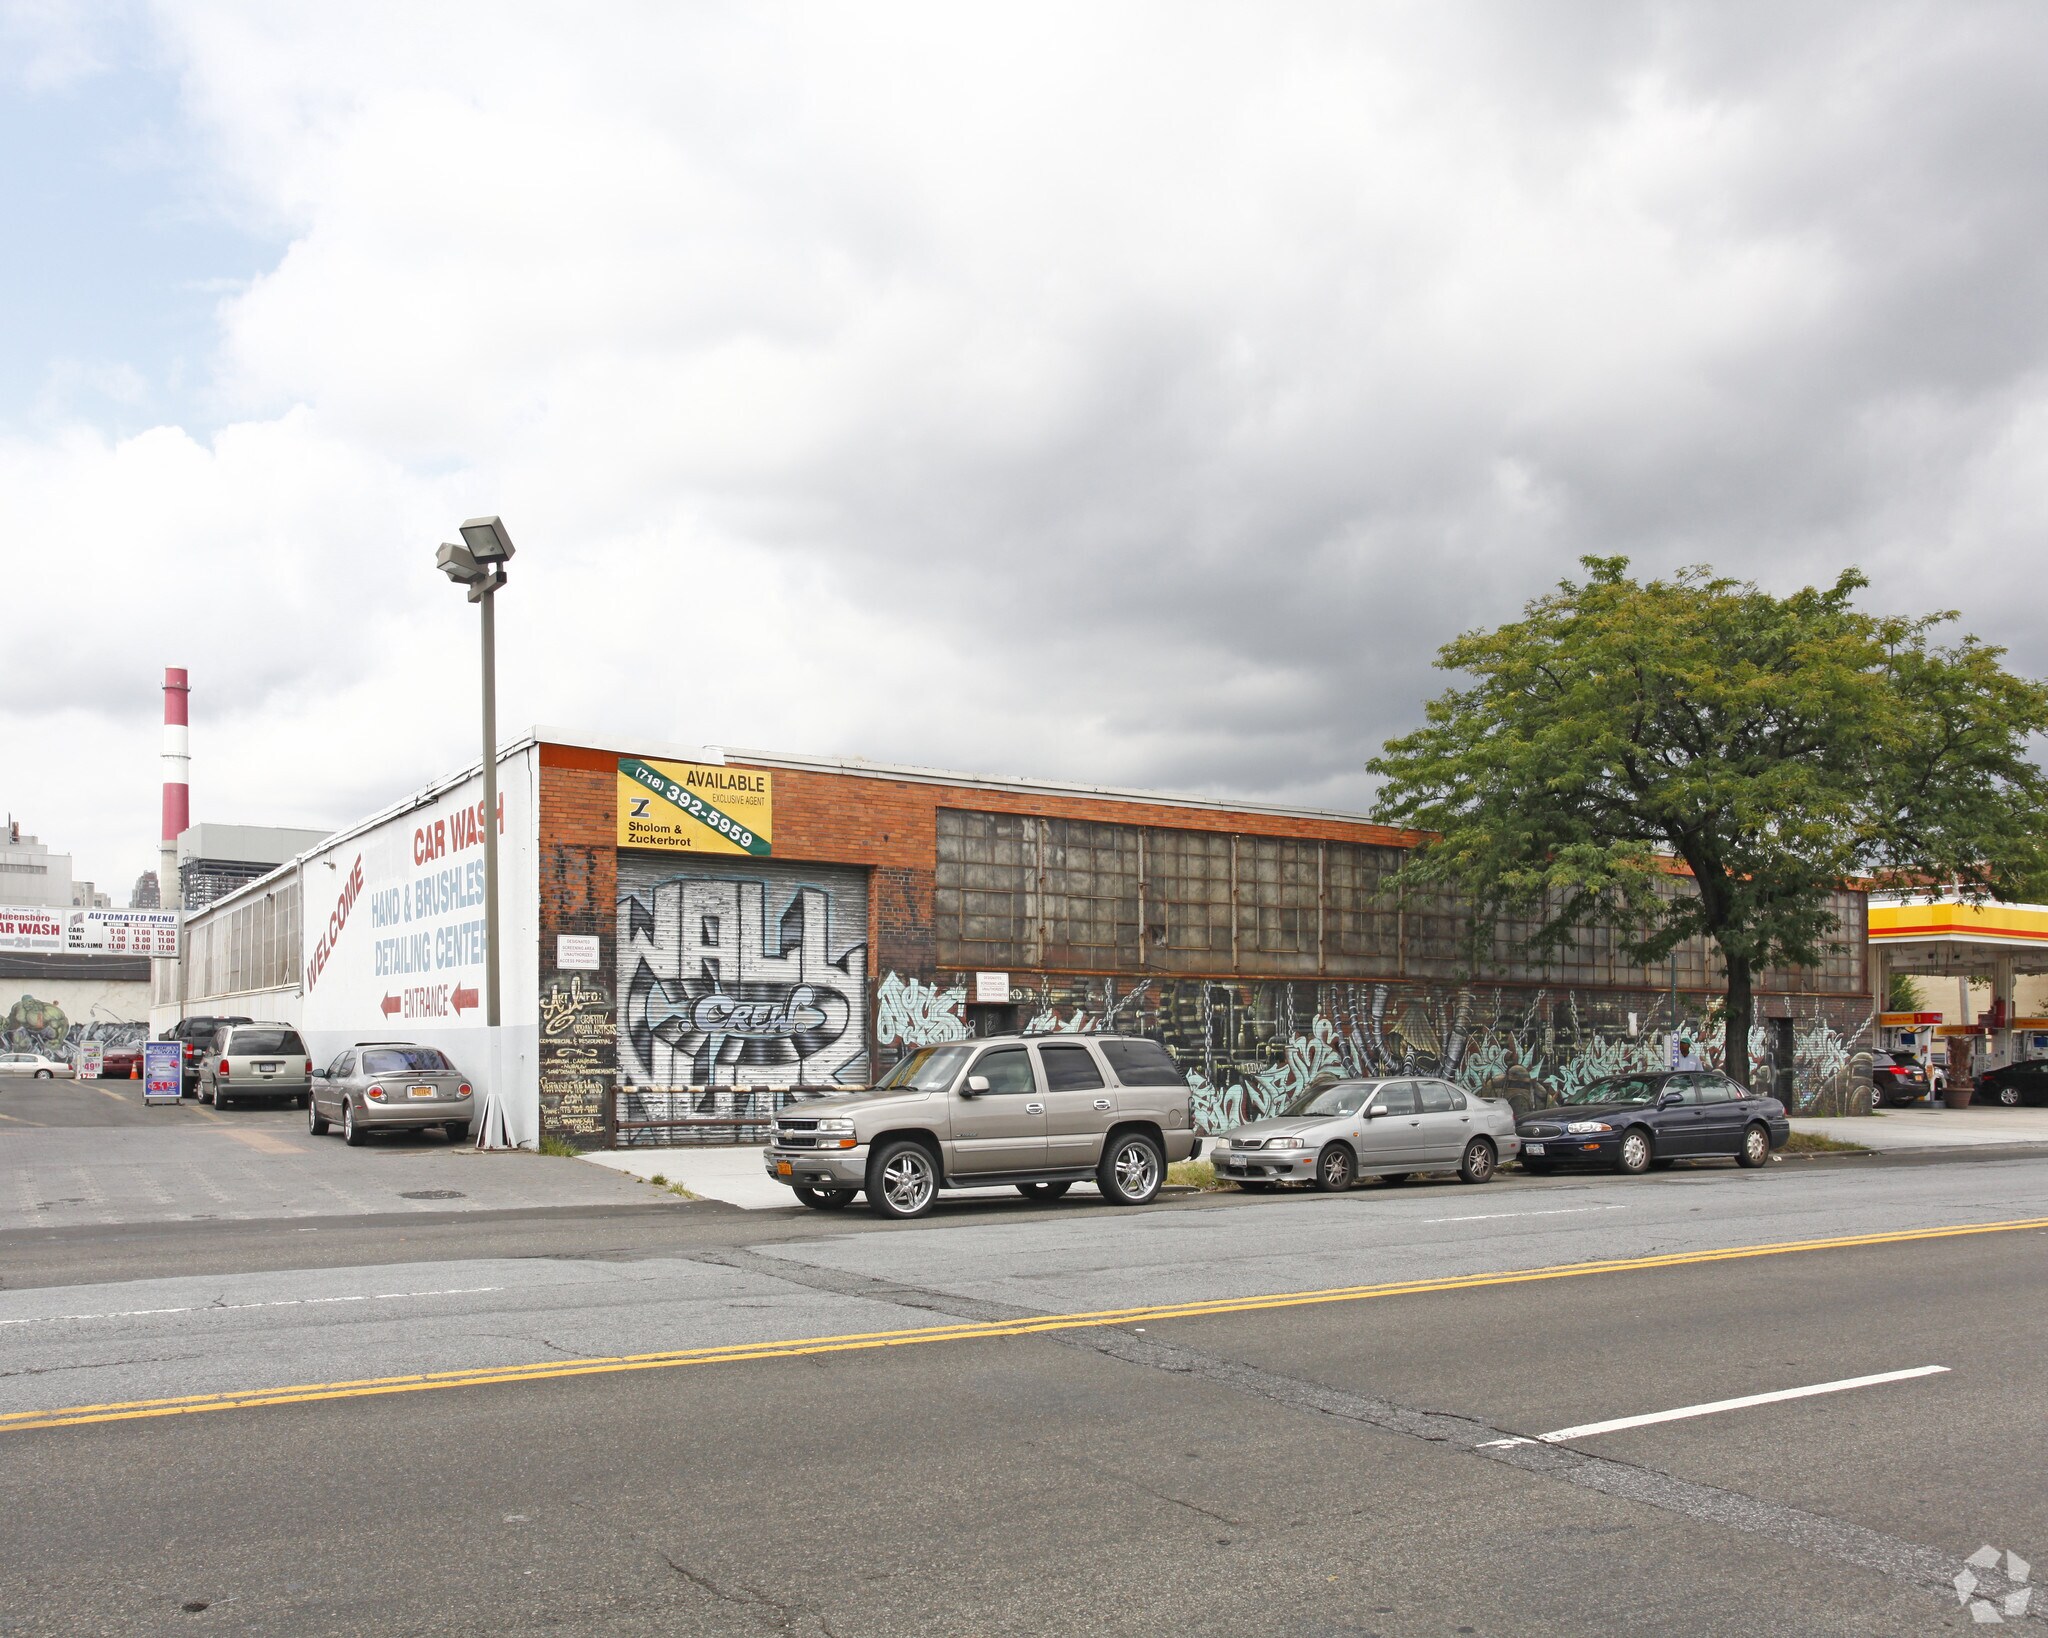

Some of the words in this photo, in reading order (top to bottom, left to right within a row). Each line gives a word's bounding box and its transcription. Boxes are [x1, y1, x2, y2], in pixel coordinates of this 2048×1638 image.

[686, 770, 765, 793] AVAILABLE
[635, 767, 665, 791] (718)
[666, 785, 753, 847] 392-5959
[712, 793, 744, 805] EXCLUSIVE
[745, 796, 765, 806] AGENT
[628, 822, 671, 834] Sholom
[673, 825, 682, 834] &
[414, 819, 445, 866] CAR
[628, 833, 691, 847] Zuckerbrot
[371, 887, 400, 929] HAND
[403, 884, 412, 923] &
[415, 858, 485, 920] BRUSHLES
[0, 912, 50, 922] ueensboro
[88, 912, 147, 922] AUTOMATED
[149, 915, 175, 923] MENU
[306, 852, 364, 993] WELCOME
[18, 922, 60, 936] WASH
[15, 936, 31, 948] 24
[375, 931, 431, 976] DETAILING
[404, 983, 448, 1019] ENTRANCE
